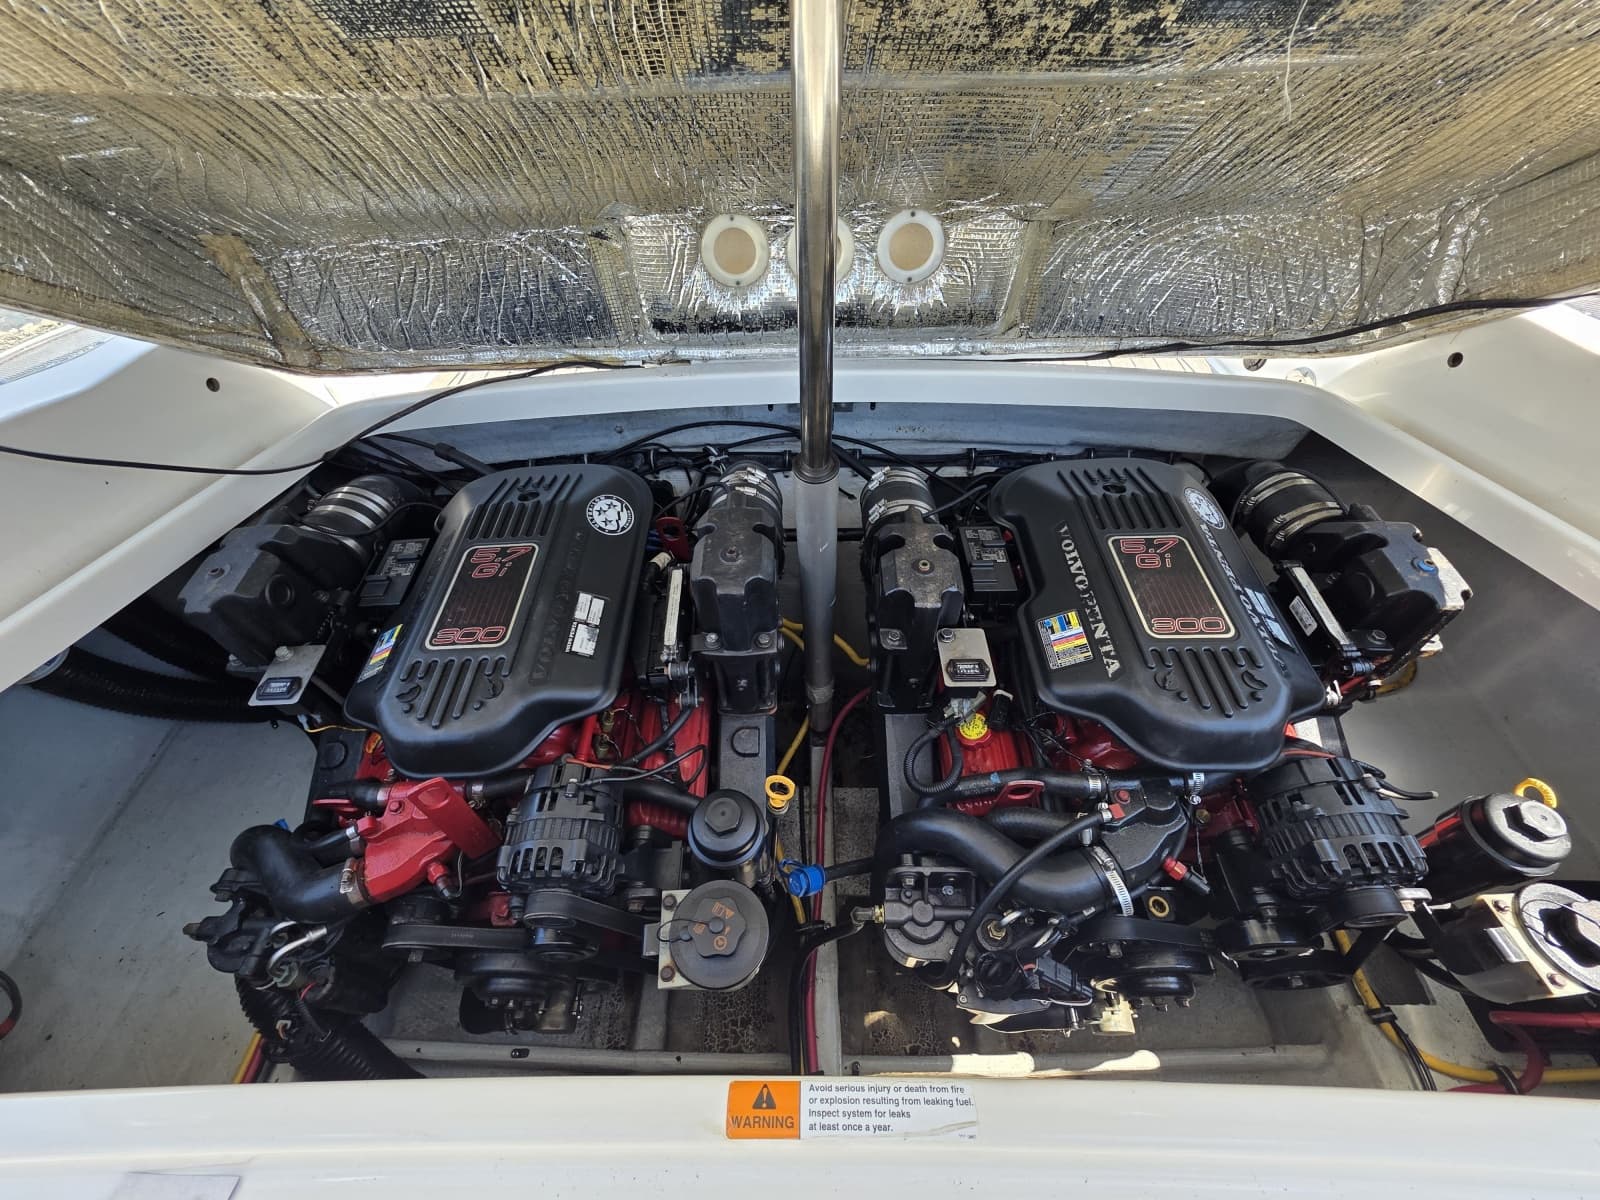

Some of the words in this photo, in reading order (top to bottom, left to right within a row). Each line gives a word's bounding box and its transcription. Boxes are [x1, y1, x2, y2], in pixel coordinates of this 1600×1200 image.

[1120, 538, 1179, 554] 5.7
[470, 547, 533, 563] 5.7
[1151, 616, 1226, 634] 300
[432, 626, 506, 644] 300
[808, 1084, 833, 1093] Avoid
[834, 1084, 866, 1093] serious
[867, 1084, 891, 1095] injury
[893, 1085, 902, 1093] or
[904, 1084, 928, 1093] death
[929, 1085, 949, 1093] from
[950, 1085, 965, 1094] fire
[808, 1097, 818, 1105] or
[819, 1096, 861, 1106] explosion
[862, 1096, 900, 1107] resulting
[901, 1097, 921, 1106] from
[923, 1097, 954, 1108] leaking
[956, 1097, 975, 1106] fuel.
[808, 1109, 840, 1119] Inspect
[841, 1109, 872, 1120] system
[874, 1110, 886, 1118] for
[888, 1110, 911, 1119] leaks
[731, 1115, 795, 1129] WARNING
[808, 1123, 817, 1131] at
[819, 1122, 840, 1131] least
[841, 1123, 863, 1132] once
[864, 1124, 871, 1132] a
[872, 1123, 894, 1134] year.
